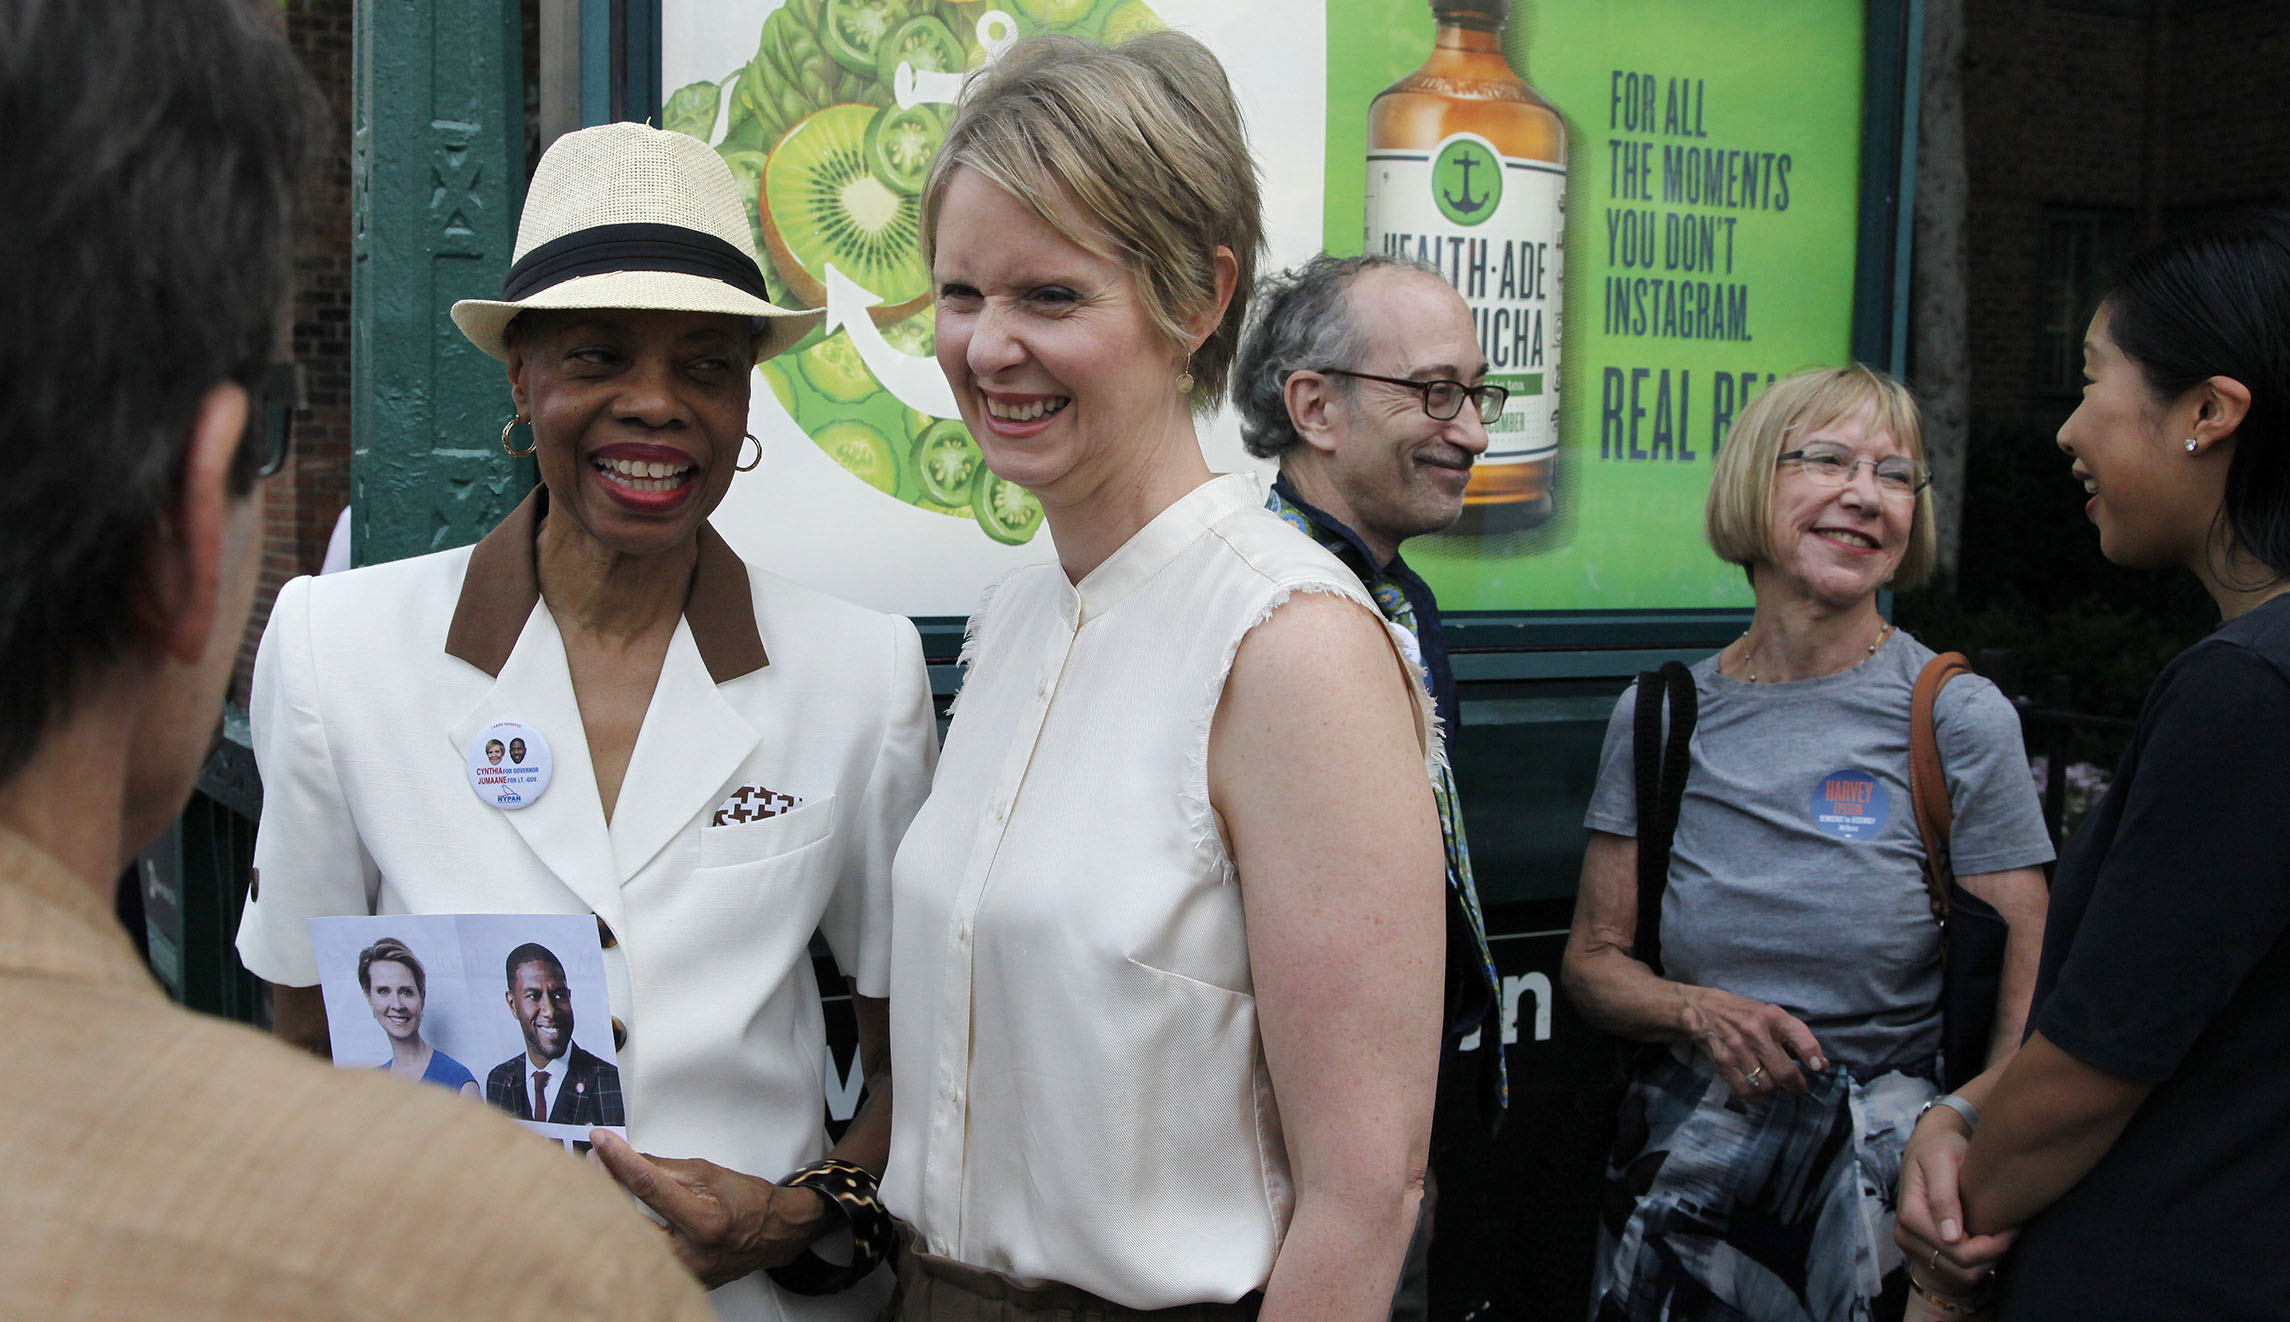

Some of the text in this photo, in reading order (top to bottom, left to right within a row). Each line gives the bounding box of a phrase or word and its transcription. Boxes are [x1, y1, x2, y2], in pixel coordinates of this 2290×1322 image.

[1610, 69, 1707, 138] FOR ALL
[1608, 138, 1792, 212] THE MOMENTS
[1606, 207, 1737, 275] YOU DON'T
[1604, 275, 1752, 342] INSTAGRAM.
[1601, 366, 1696, 462] REAL
[476, 767, 503, 776] CYNTHIA
[513, 766, 539, 774] GOVERNOR
[478, 776, 507, 785] JUMAANE
[1826, 781, 1873, 803] HARVEY
